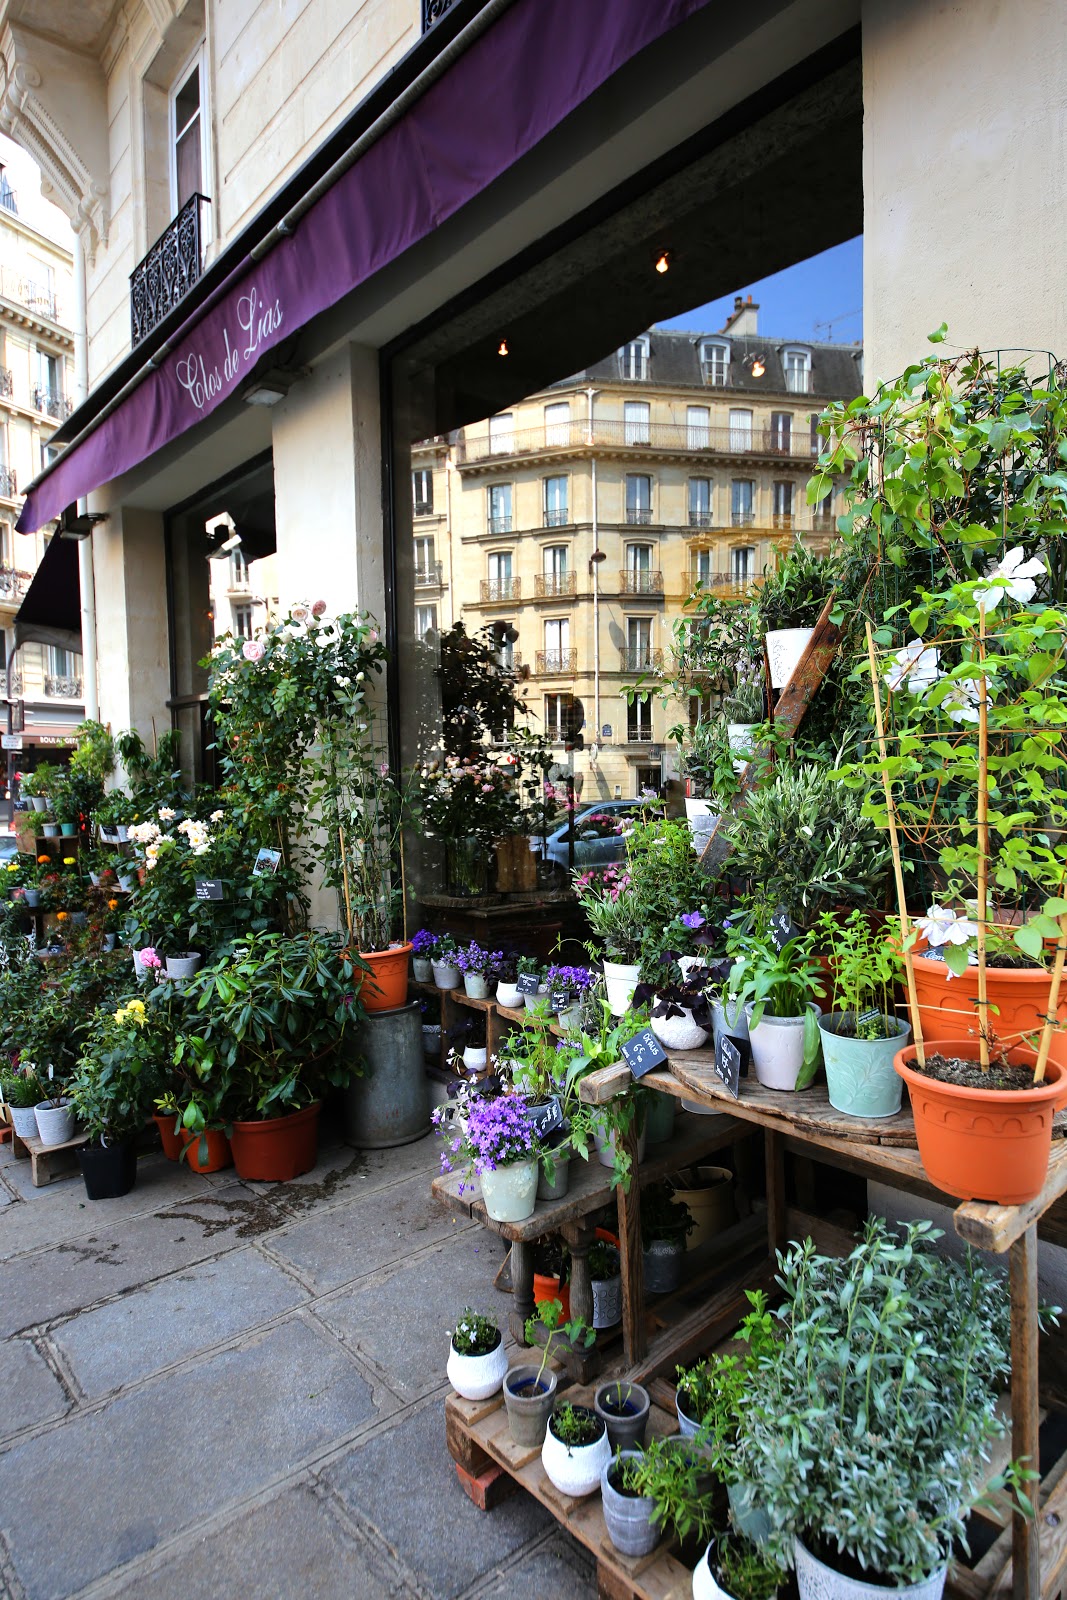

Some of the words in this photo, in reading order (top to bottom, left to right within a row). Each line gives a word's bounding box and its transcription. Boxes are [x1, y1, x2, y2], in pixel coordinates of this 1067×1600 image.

[176, 353, 222, 411] Clos
[224, 328, 239, 381] de
[237, 287, 283, 360] Lias
[642, 1032, 660, 1056] OXALIS
